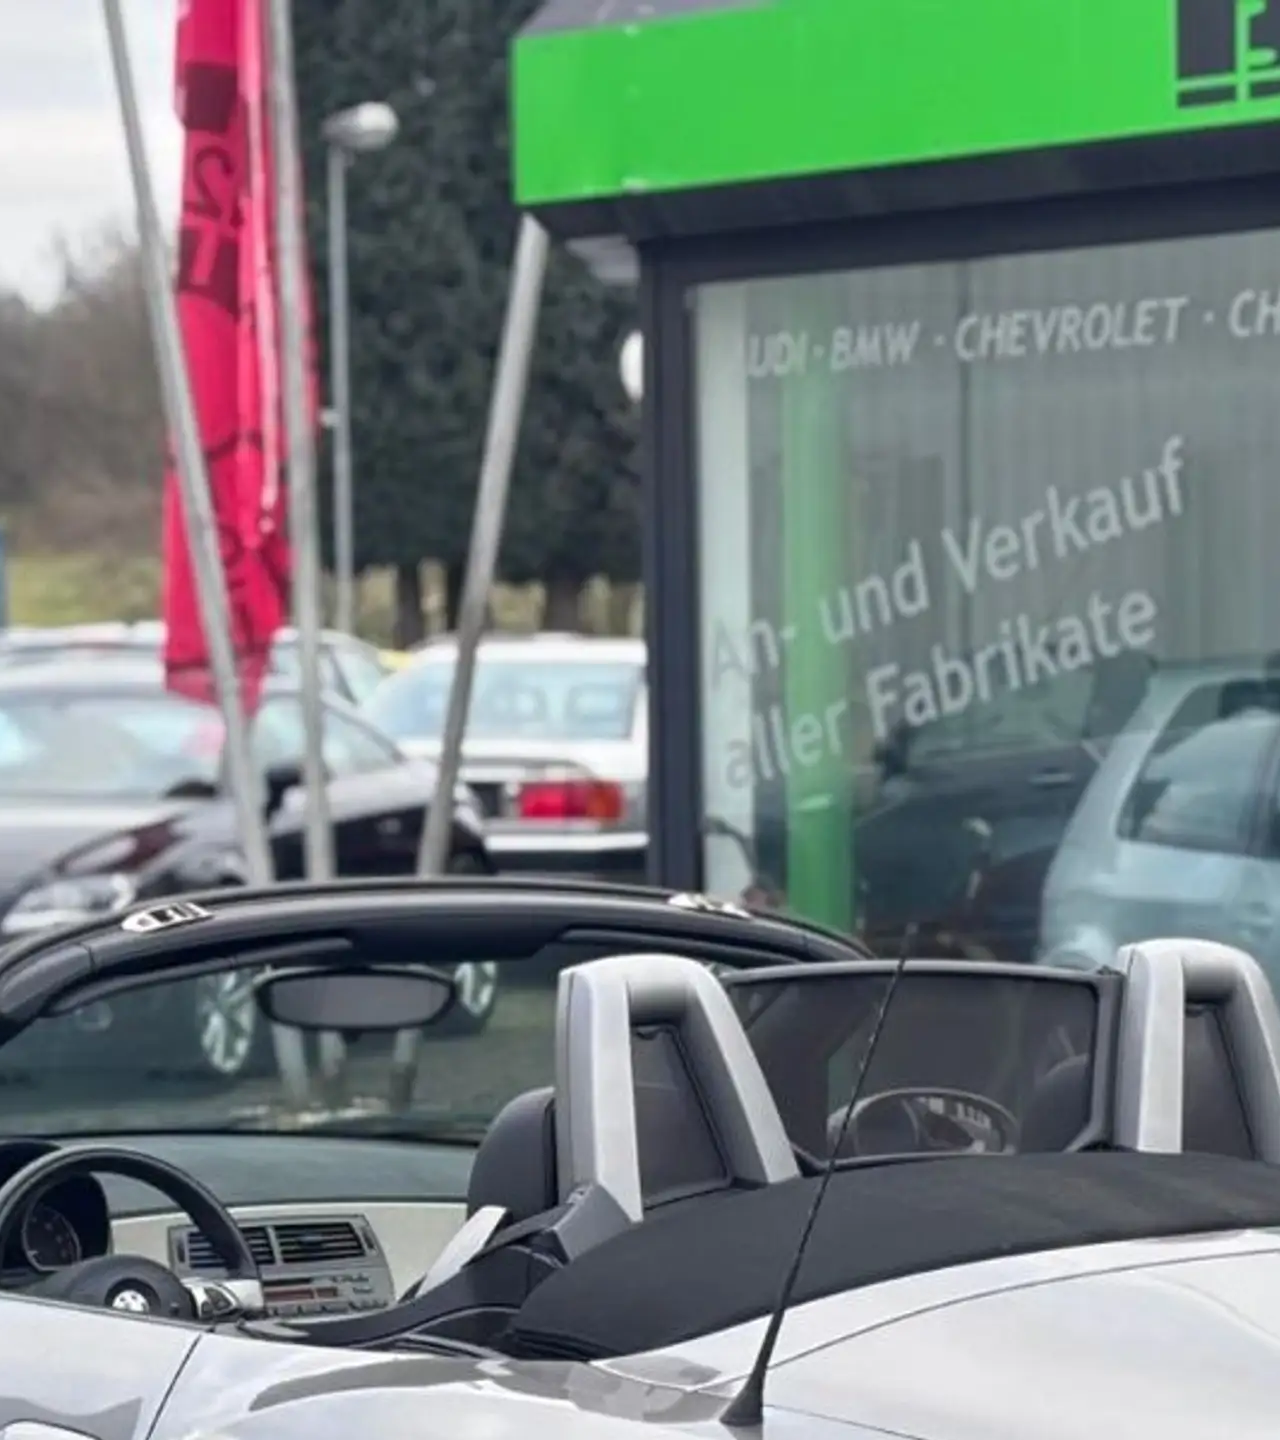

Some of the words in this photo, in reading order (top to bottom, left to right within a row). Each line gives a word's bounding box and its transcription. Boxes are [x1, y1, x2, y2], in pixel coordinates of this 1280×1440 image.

[831, 320, 920, 373] BMW
[954, 297, 1189, 362] CHEVROLET
[818, 538, 930, 645] und
[940, 434, 1186, 594] Verkauf
[723, 698, 849, 790] aller
[865, 588, 1158, 740] Fabrikate
